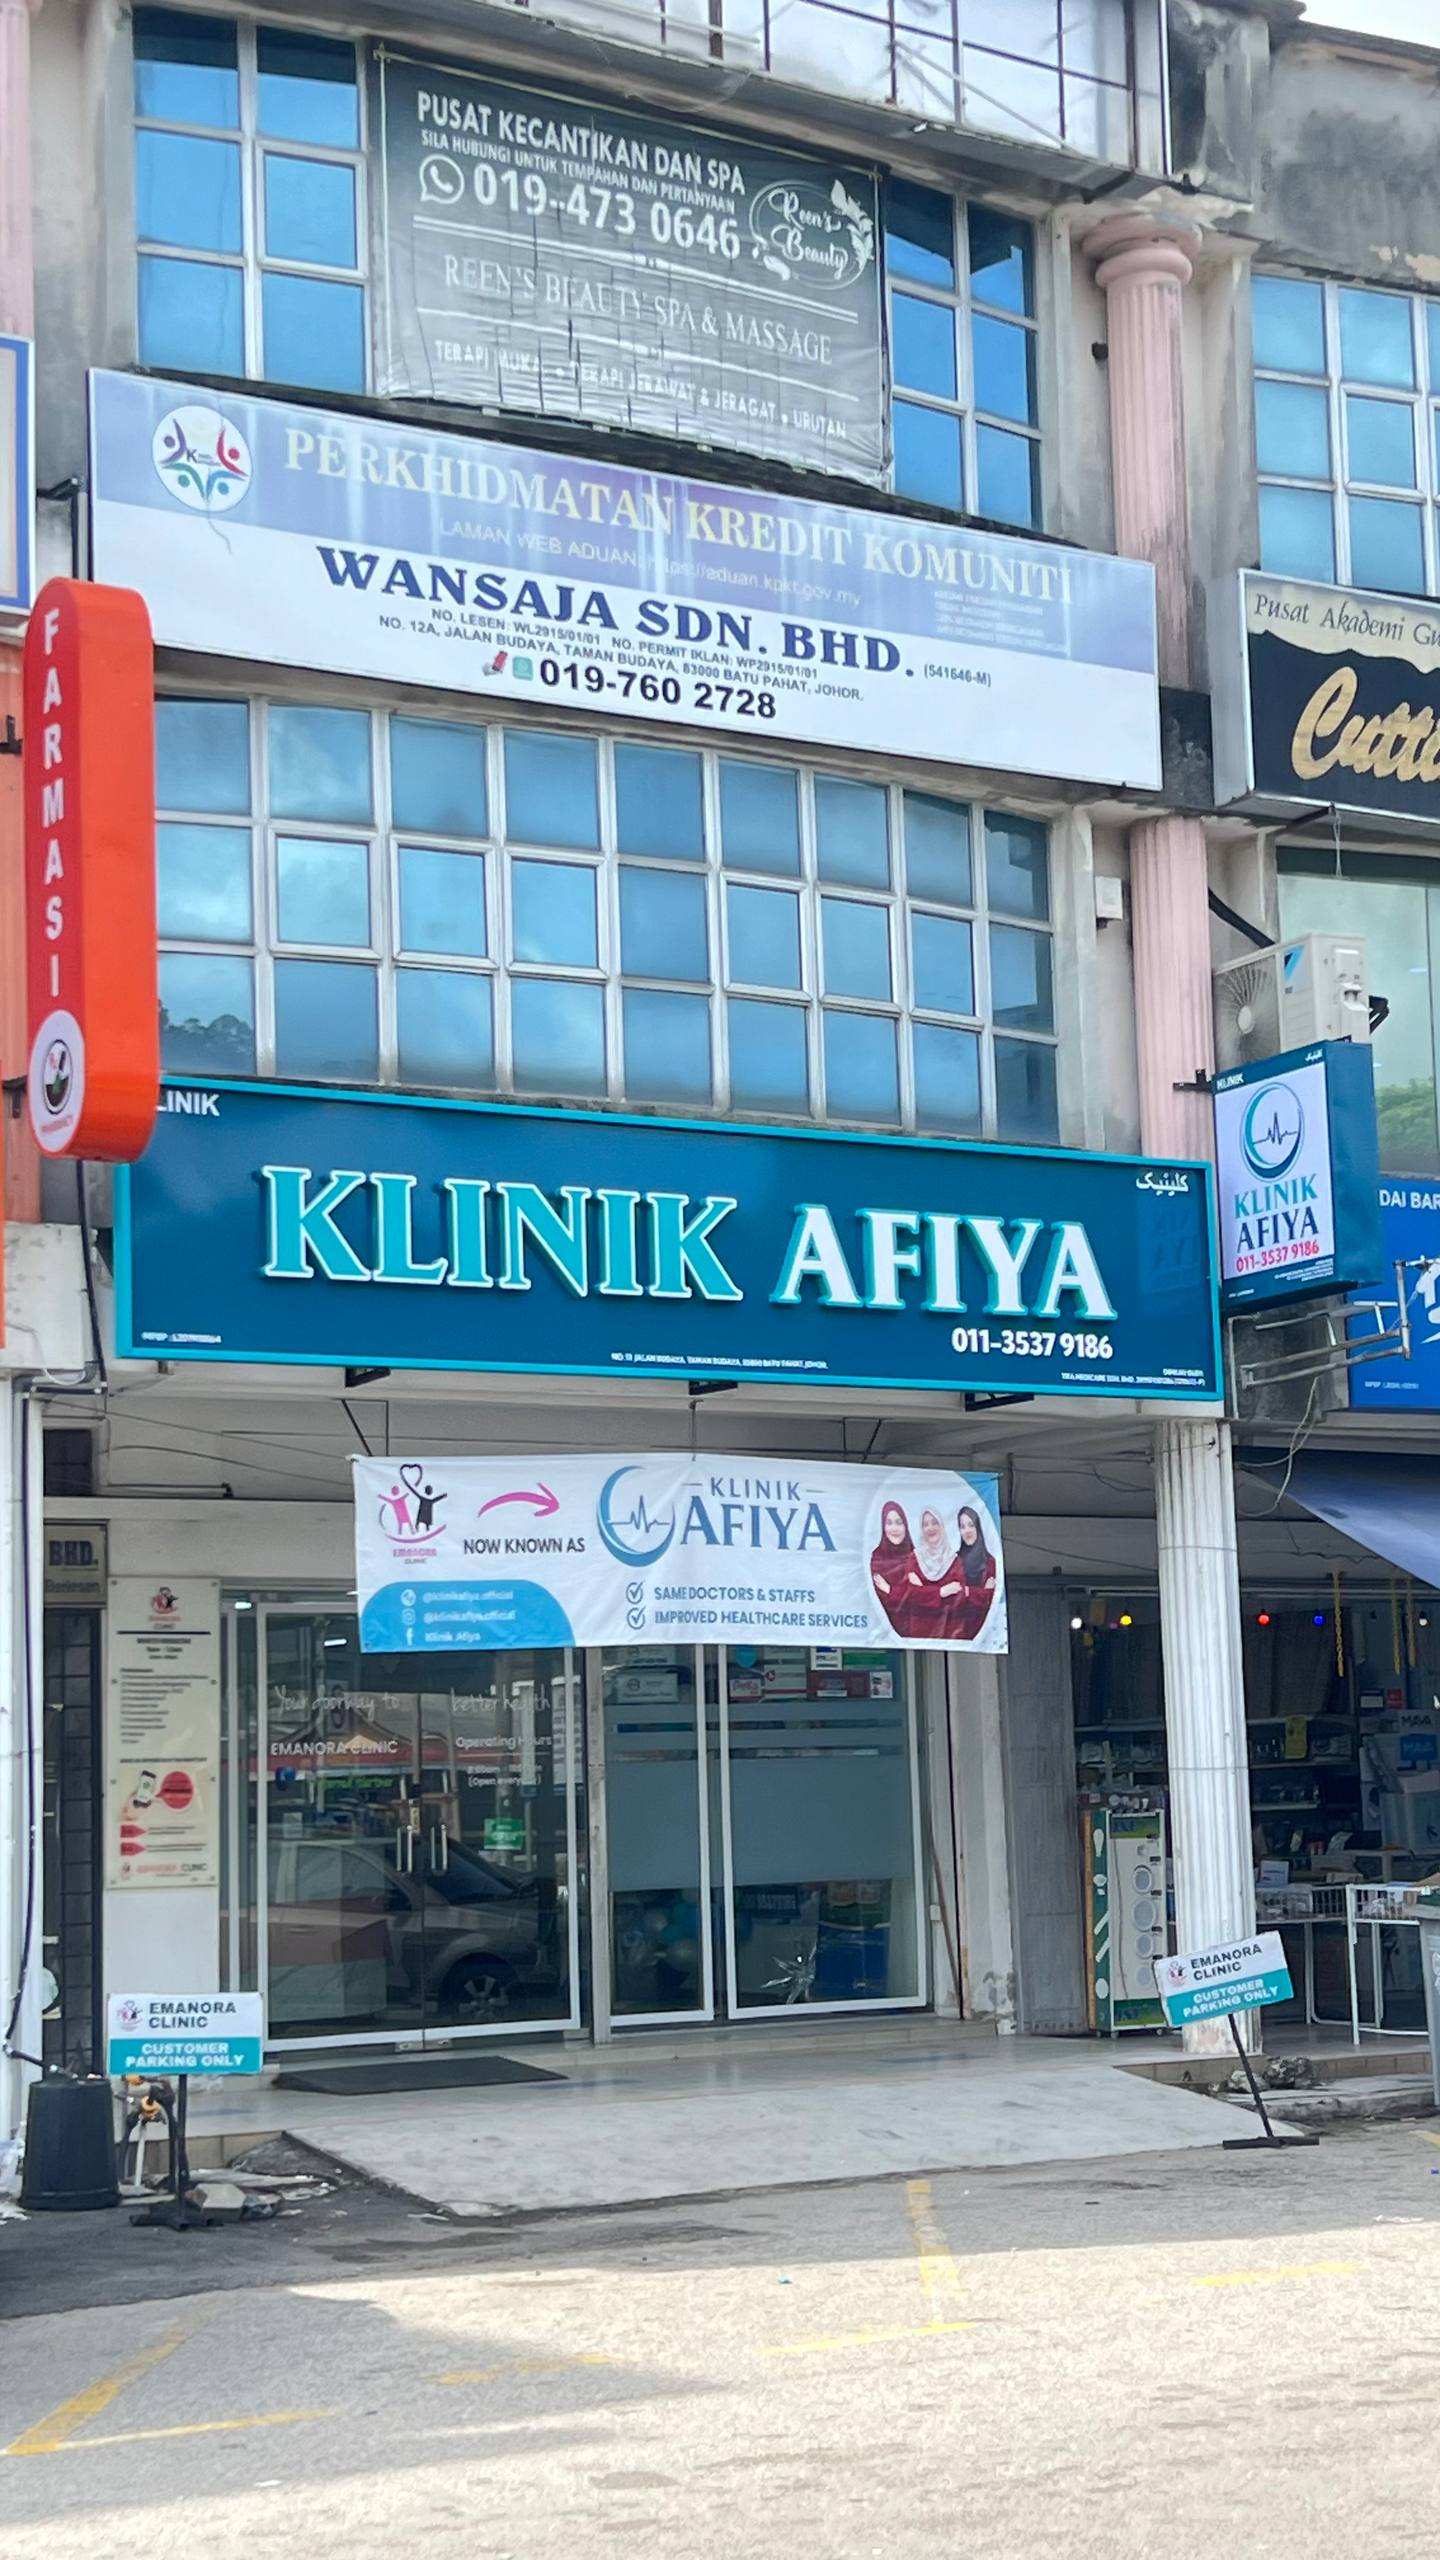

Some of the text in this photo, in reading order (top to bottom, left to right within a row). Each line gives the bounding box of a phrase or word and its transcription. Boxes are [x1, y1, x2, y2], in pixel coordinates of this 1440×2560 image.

[418, 90, 746, 195] PUSAT KECANTIKAN DAN SPA
[421, 129, 735, 214] SILA HUBUNGI UNTUK TEMPAHAN DAN PERTANYAAN
[473, 163, 740, 259] 019-473 0646
[768, 187, 841, 233] Reen's
[770, 223, 848, 280] Beauty
[445, 254, 833, 365] REEN'S BEAUTY SPA & MASSAGE
[435, 340, 488, 370] TERAPI
[700, 387, 709, 407] &
[714, 389, 777, 422] JERAGAT
[793, 409, 847, 439] URUTAN
[284, 427, 1073, 604] PERKHIDMATAN KREDIT KOMUNITI
[440, 519, 508, 547] LAMAN
[518, 533, 562, 555] WEB
[316, 546, 619, 630] WANSAJA
[635, 598, 768, 655] SDN.
[781, 621, 914, 678] BHD.
[924, 664, 992, 687] (541646-M)
[431, 607, 456, 623] NO.
[611, 636, 635, 650] NO.
[639, 641, 688, 658] PERMIT
[1254, 593, 1310, 625] Pusat
[1319, 600, 1406, 641] Akademi
[379, 615, 405, 629] NO.
[410, 620, 440, 637] 12A,
[445, 626, 492, 644] JALAN
[496, 633, 560, 656] BUDAYA,
[563, 643, 614, 663] TAMAN
[617, 653, 680, 675] BUDAYA,
[723, 670, 759, 686] BATU
[763, 676, 812, 695] PAHAT,
[539, 658, 777, 720] 019-760 2728
[42, 608, 66, 998] FARMASI
[1234, 1173, 1318, 1219] KLINIK
[261, 1165, 1118, 1321] KLINIK AFIYA
[1237, 1205, 1319, 1254] AFIYA
[1236, 1246, 1289, 1273] 011-3537
[1291, 1240, 1320, 1260] 9186
[951, 1327, 1113, 1360] 011-3537 9186
[710, 1477, 801, 1501] KLINIK
[680, 1495, 838, 1552] AFIYA
[464, 1536, 585, 1555] NOW KNOWN AS
[654, 1586, 816, 1603] SAME DOCTORS & STAFFS
[655, 1610, 869, 1628] IMPROVED HEALTHCARE SERVICES
[382, 1692, 399, 1710] to
[451, 1686, 497, 1713] better
[270, 1740, 398, 1756] EMANORA CLINIC
[455, 1736, 516, 1749] Operating
[1190, 1943, 1262, 1969] EMANORA
[1193, 1961, 1242, 1981] CLINIC
[149, 2001, 236, 2014] EMANORA
[1183, 1986, 1279, 2017] PARKING ONLY
[1193, 1979, 1264, 2004] CUSTOMER
[149, 2016, 208, 2029] CLINIC
[125, 2054, 244, 2068] PARKING ONLY
[141, 2042, 229, 2055] CUSTOMER
